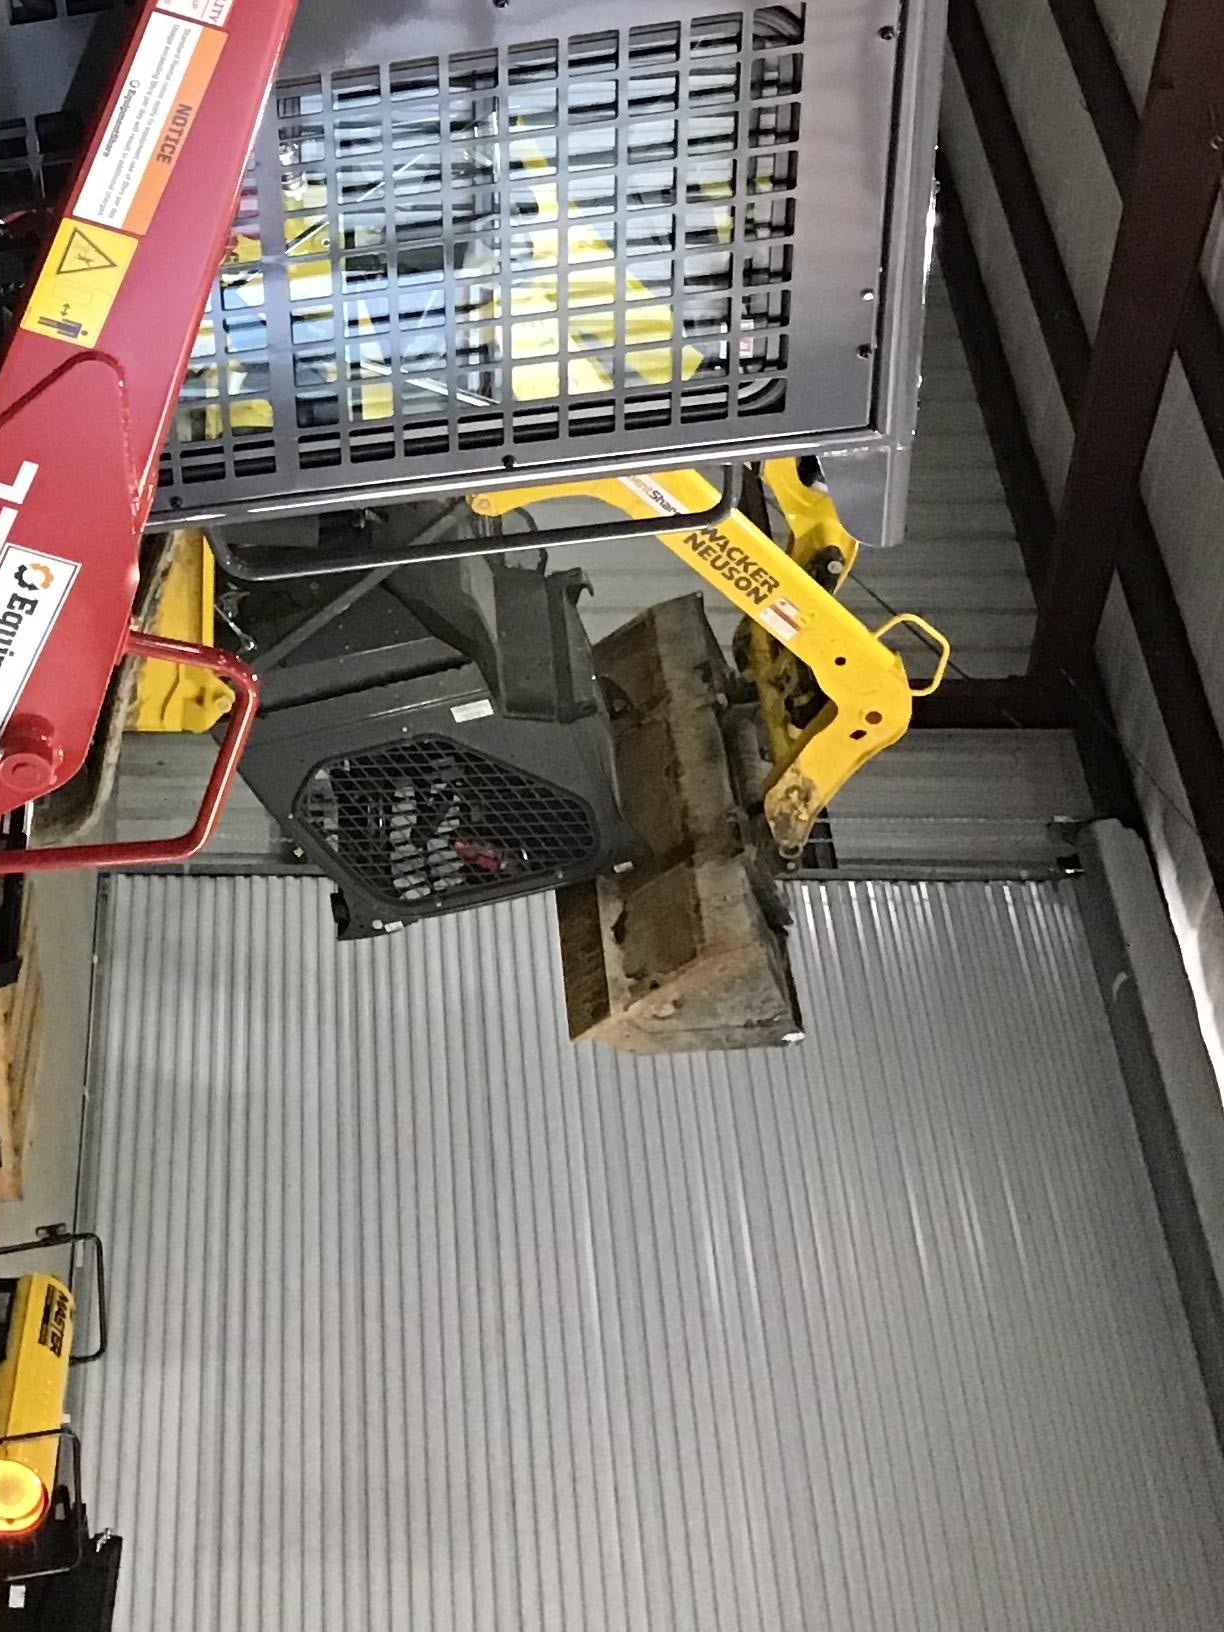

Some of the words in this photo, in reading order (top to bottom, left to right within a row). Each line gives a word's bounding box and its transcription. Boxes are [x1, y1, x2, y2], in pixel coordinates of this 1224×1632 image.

[103, 89, 137, 157] EquipmentShare
[156, 103, 193, 164] NOTICE
[683, 533, 768, 605] NEUSON
[701, 527, 780, 594] WACKER
[50, 1290, 69, 1359] MASTER
